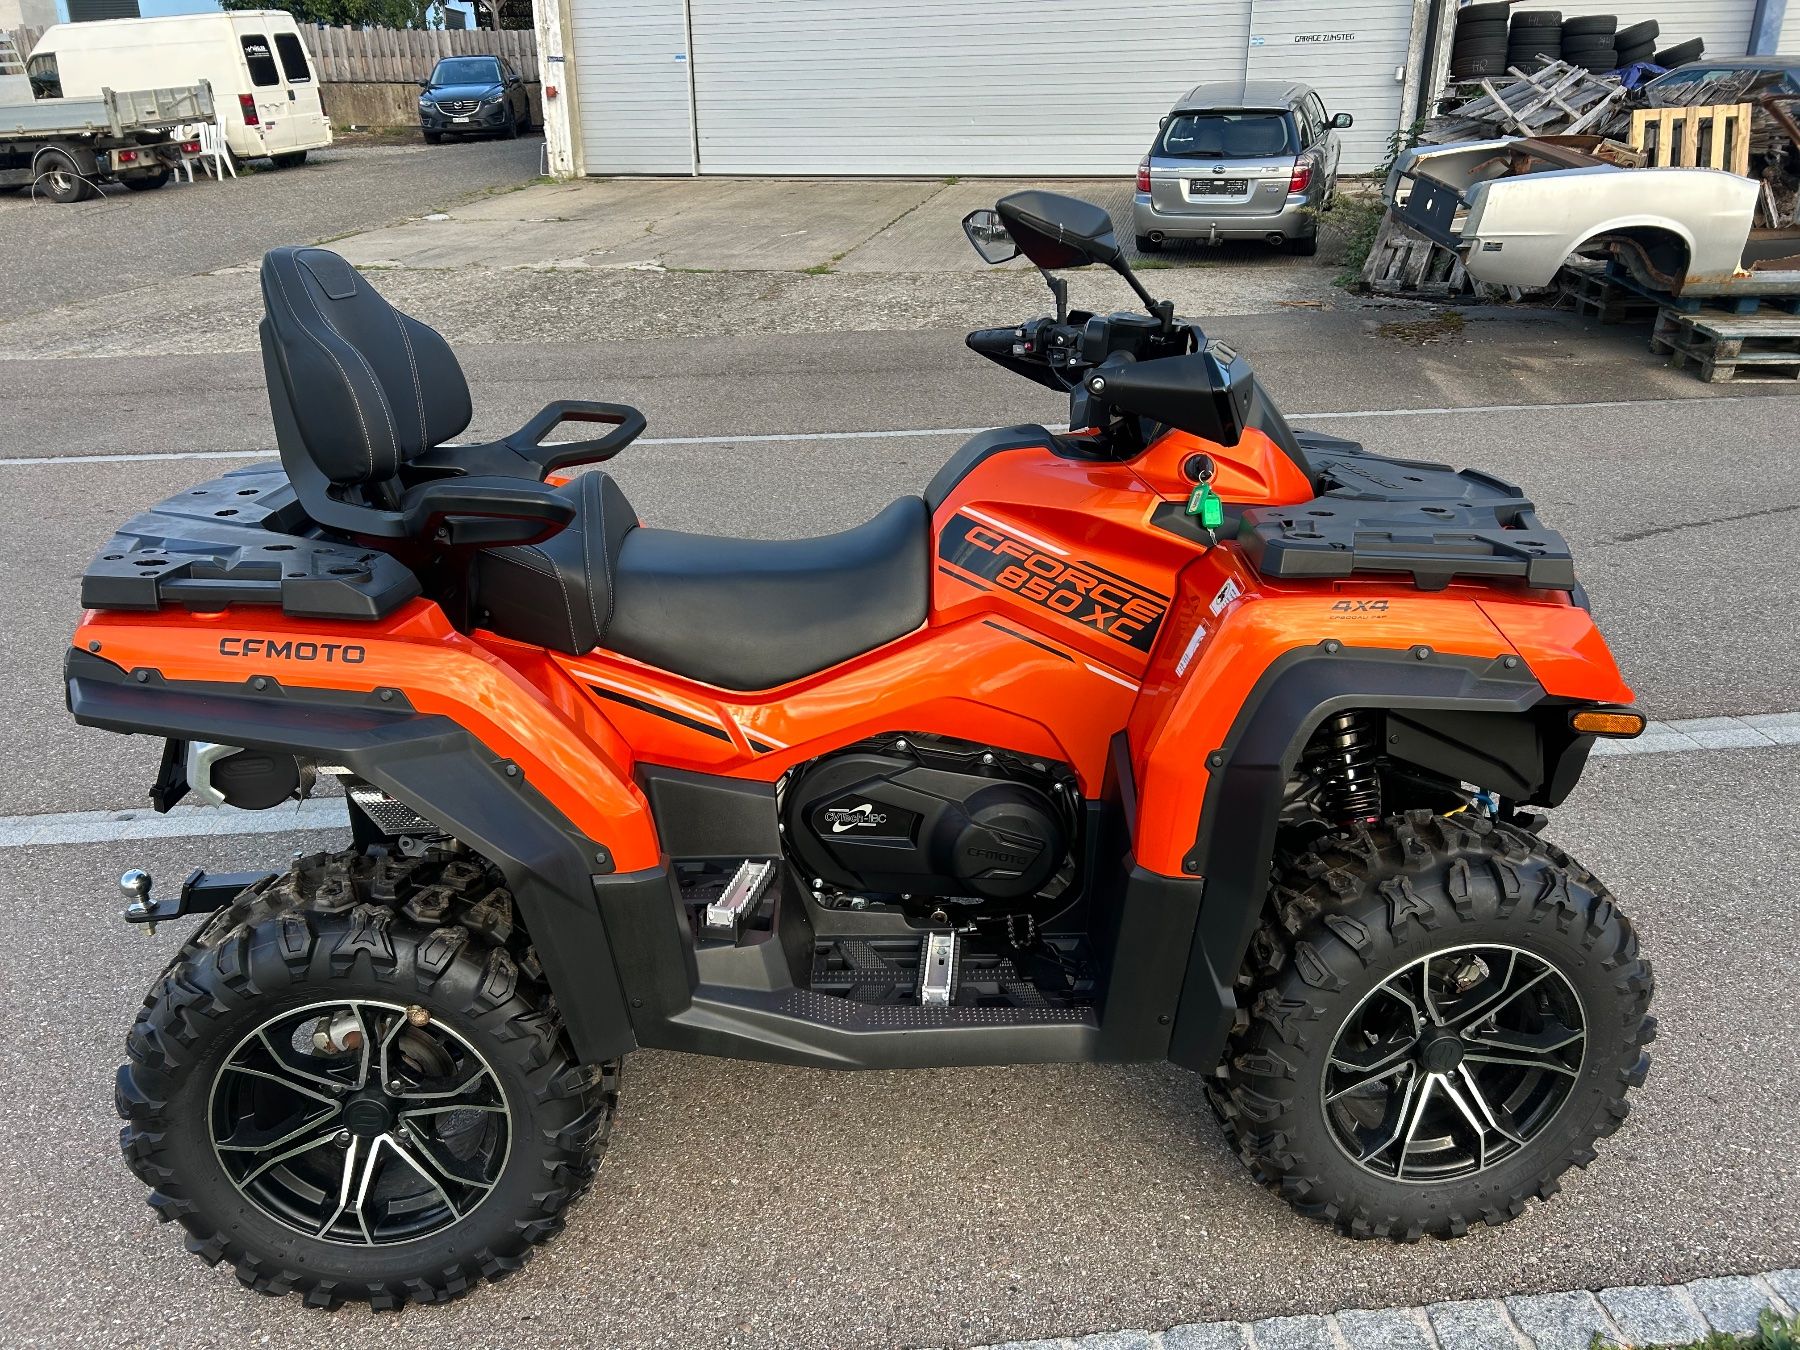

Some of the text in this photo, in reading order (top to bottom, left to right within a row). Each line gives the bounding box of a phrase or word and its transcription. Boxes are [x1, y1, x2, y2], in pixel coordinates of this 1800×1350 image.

[1294, 34, 1322, 42] GARAGE
[964, 526, 1165, 623] CFORCE
[995, 565, 1145, 641] 850 XC
[1331, 600, 1390, 612] 4X4
[219, 637, 366, 664] CFMOTO
[967, 846, 1027, 865] CFMOTO
